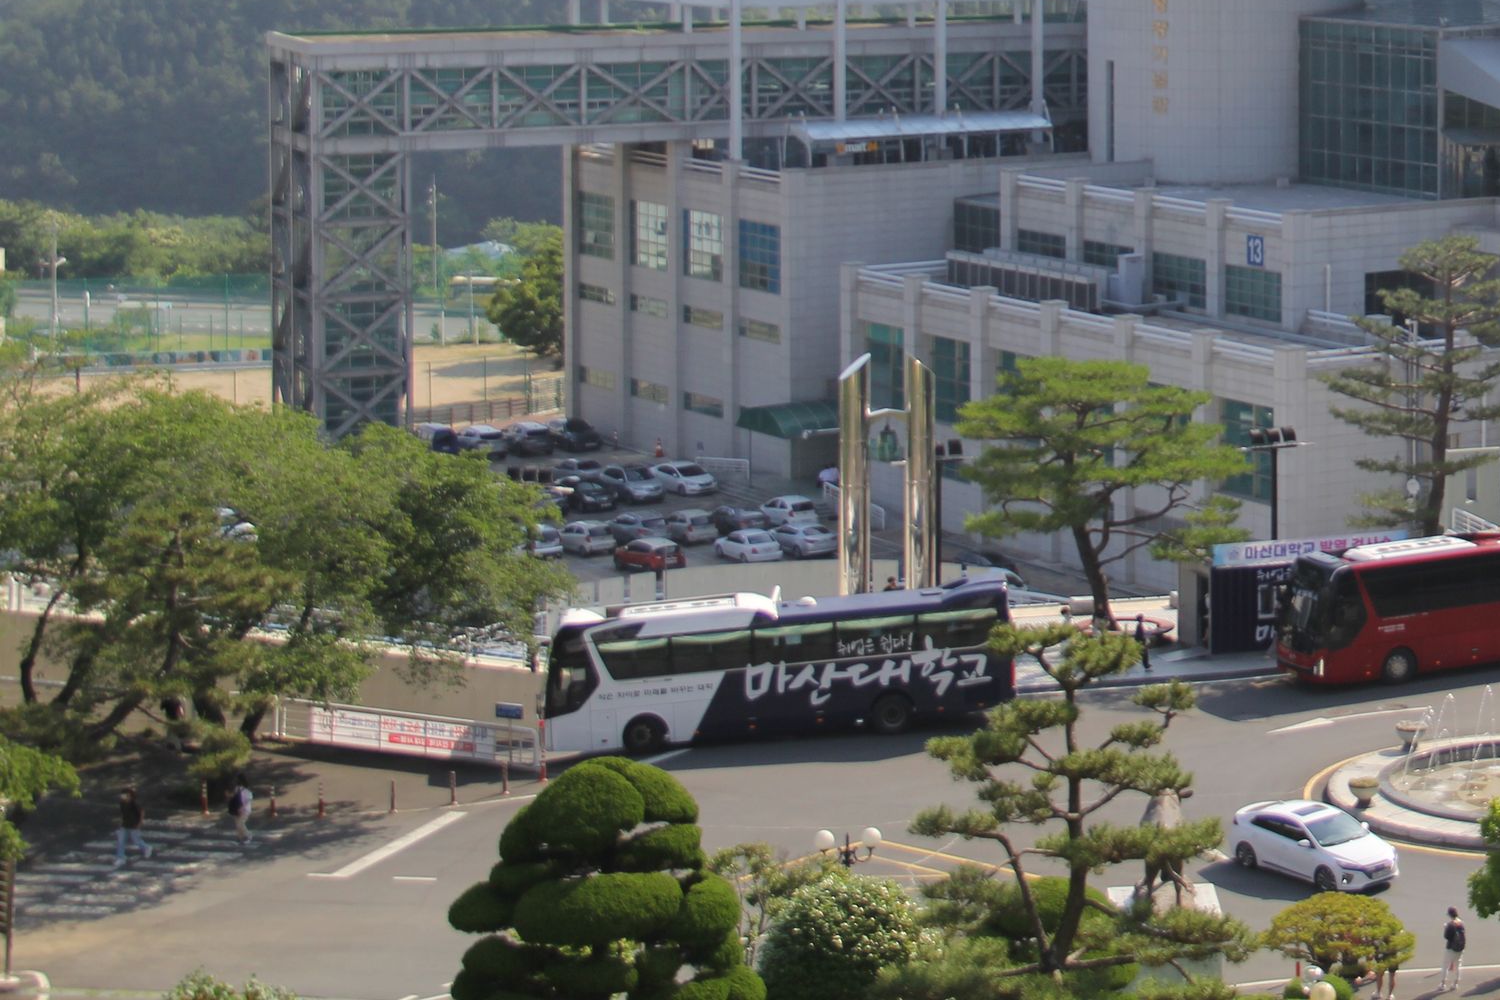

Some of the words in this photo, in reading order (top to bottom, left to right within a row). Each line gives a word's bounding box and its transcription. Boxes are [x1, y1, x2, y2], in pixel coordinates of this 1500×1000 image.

[1248, 237, 1262, 264] 13
[1244, 540, 1315, 560] 마산대학교
[745, 635, 993, 706] 마산대학교
